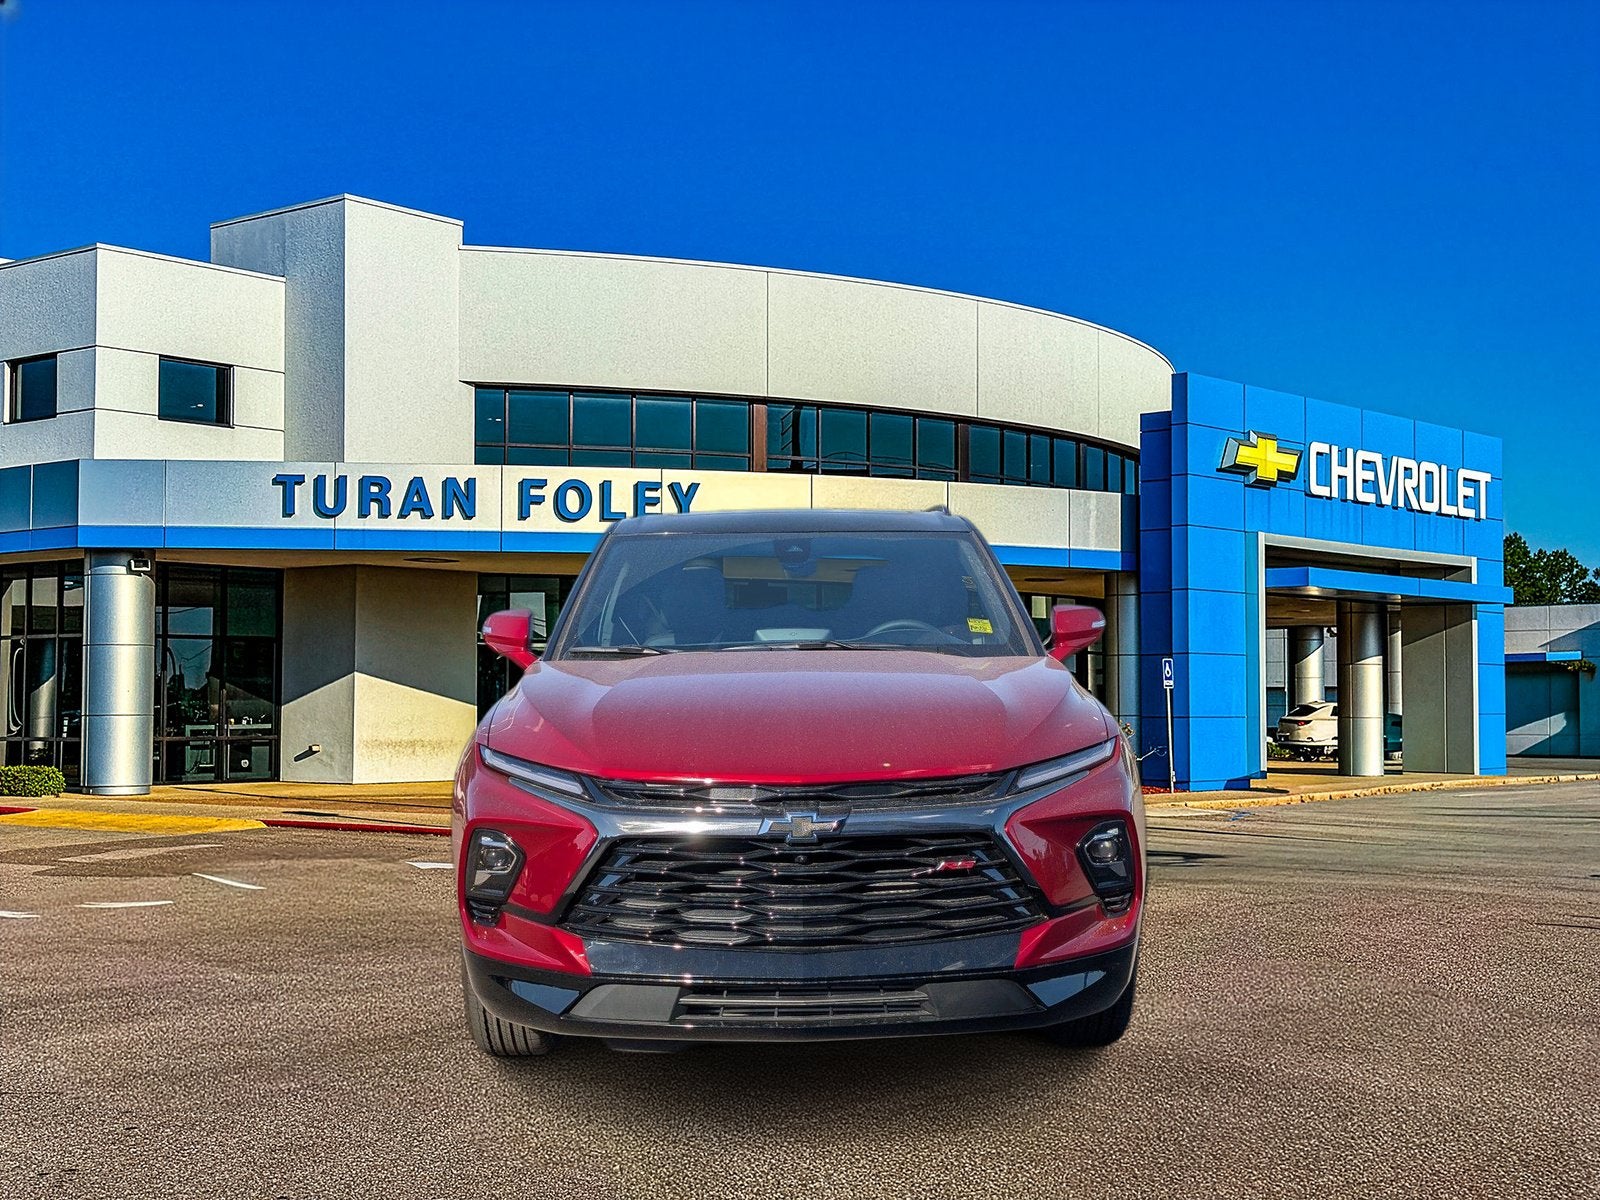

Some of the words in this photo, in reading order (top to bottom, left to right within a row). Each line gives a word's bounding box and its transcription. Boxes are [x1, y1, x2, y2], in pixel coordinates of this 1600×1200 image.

[272, 474, 477, 520] TURAN
[517, 477, 701, 522] FOLEY
[1308, 441, 1492, 520] CHEVROLET
